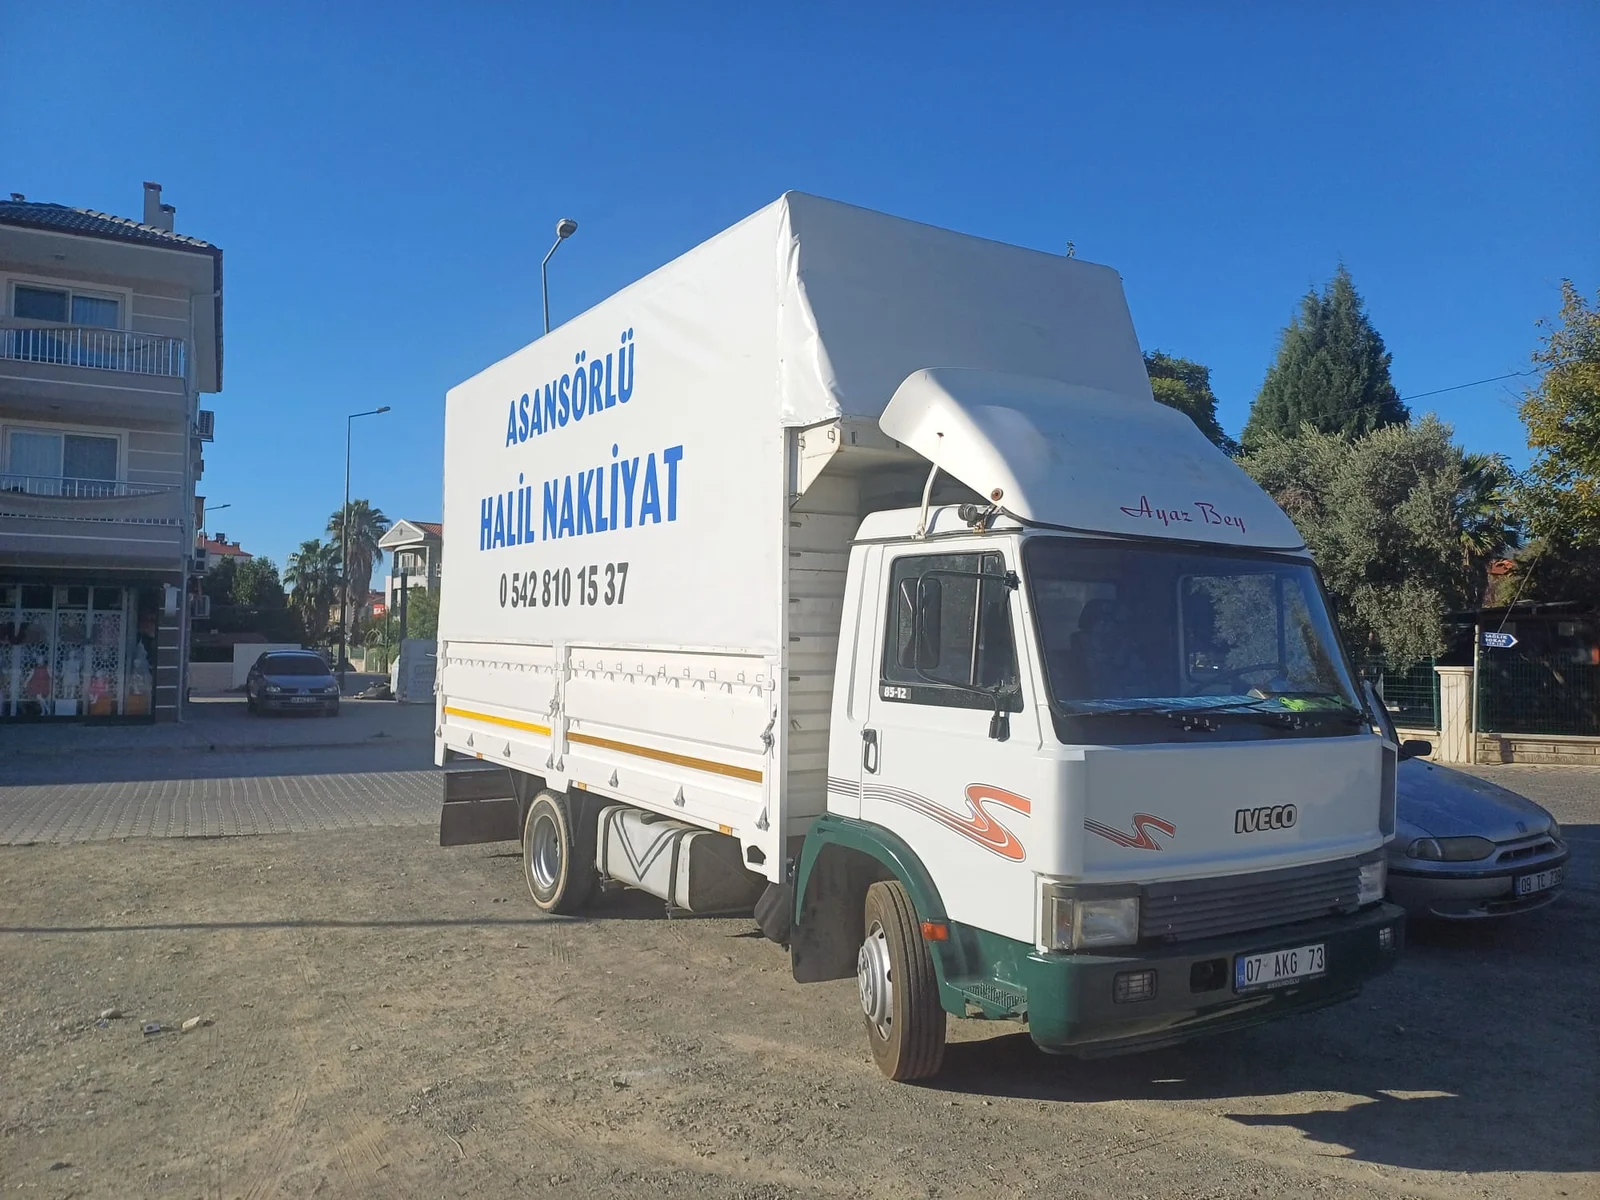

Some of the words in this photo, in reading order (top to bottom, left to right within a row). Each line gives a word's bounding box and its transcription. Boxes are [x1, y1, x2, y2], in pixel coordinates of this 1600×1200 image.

[506, 327, 635, 448] ASANSÖRLÜ
[480, 473, 535, 551] HALİL
[542, 443, 684, 541] NAKLİYAT
[1120, 495, 1193, 527] Ayaz
[1194, 502, 1246, 533] Bey
[500, 573, 508, 608] 0
[511, 571, 538, 608] 542
[542, 567, 571, 607] 810
[577, 565, 598, 606] 15
[604, 562, 629, 605] 37
[1235, 804, 1297, 833] IVECO
[1246, 958, 1261, 982] 07
[1274, 952, 1297, 977] AKG
[1308, 947, 1324, 971] 73
